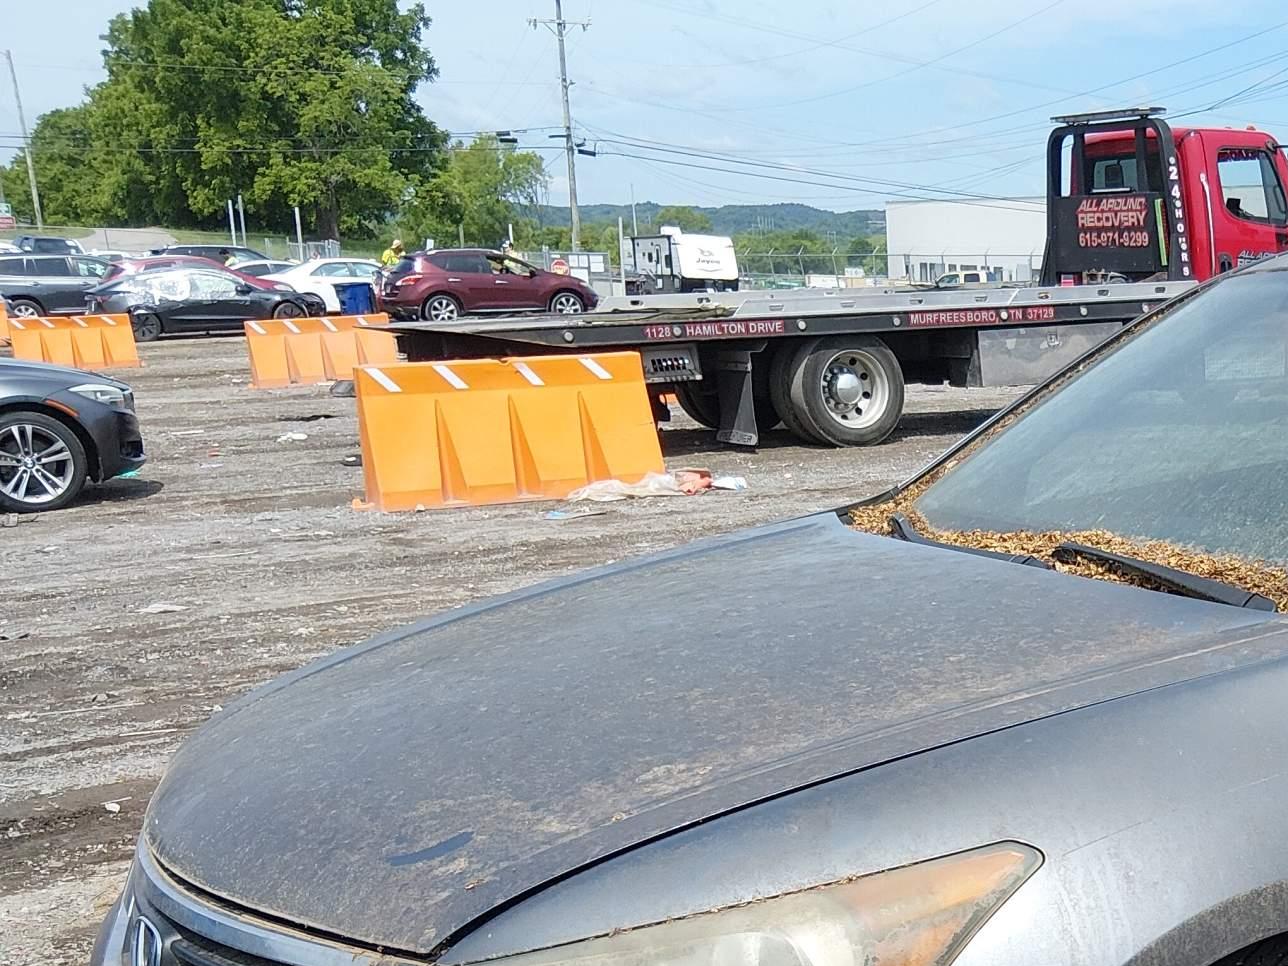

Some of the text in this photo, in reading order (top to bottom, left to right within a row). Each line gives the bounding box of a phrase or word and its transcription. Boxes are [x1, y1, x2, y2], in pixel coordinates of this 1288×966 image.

[1169, 166, 1180, 199] 24
[1077, 196, 1147, 211] ALL AROUND
[1078, 211, 1148, 228] RECOVERY
[1079, 231, 1149, 247] 615-971-9299
[1239, 250, 1255, 258] ALL
[910, 306, 1055, 325] MURFREESBORO, TN 37129
[644, 321, 783, 339] 1128 HAMILTON DRIVE
